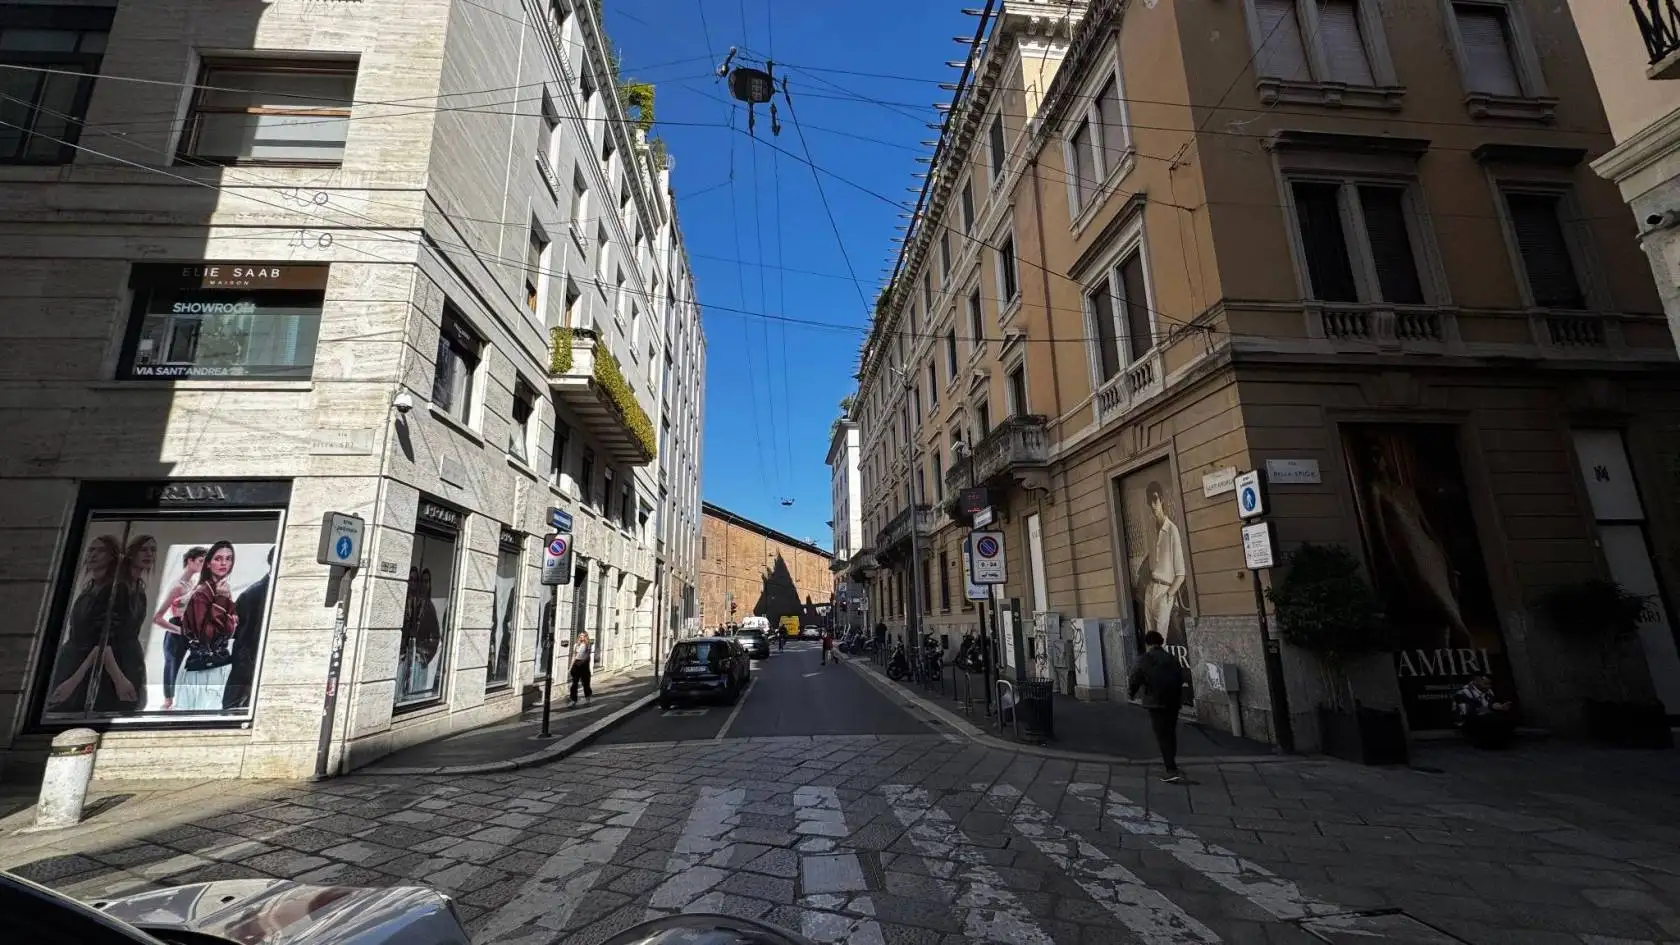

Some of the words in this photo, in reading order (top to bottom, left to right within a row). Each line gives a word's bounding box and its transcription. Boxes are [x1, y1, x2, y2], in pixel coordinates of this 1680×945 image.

[182, 267, 221, 278] ELIE
[232, 267, 281, 278] SAAB
[172, 302, 256, 314] SHOWROOM
[136, 366, 152, 376] VIA
[154, 366, 229, 376] SANT'ANDREA
[1398, 647, 1493, 678] AMIRI
